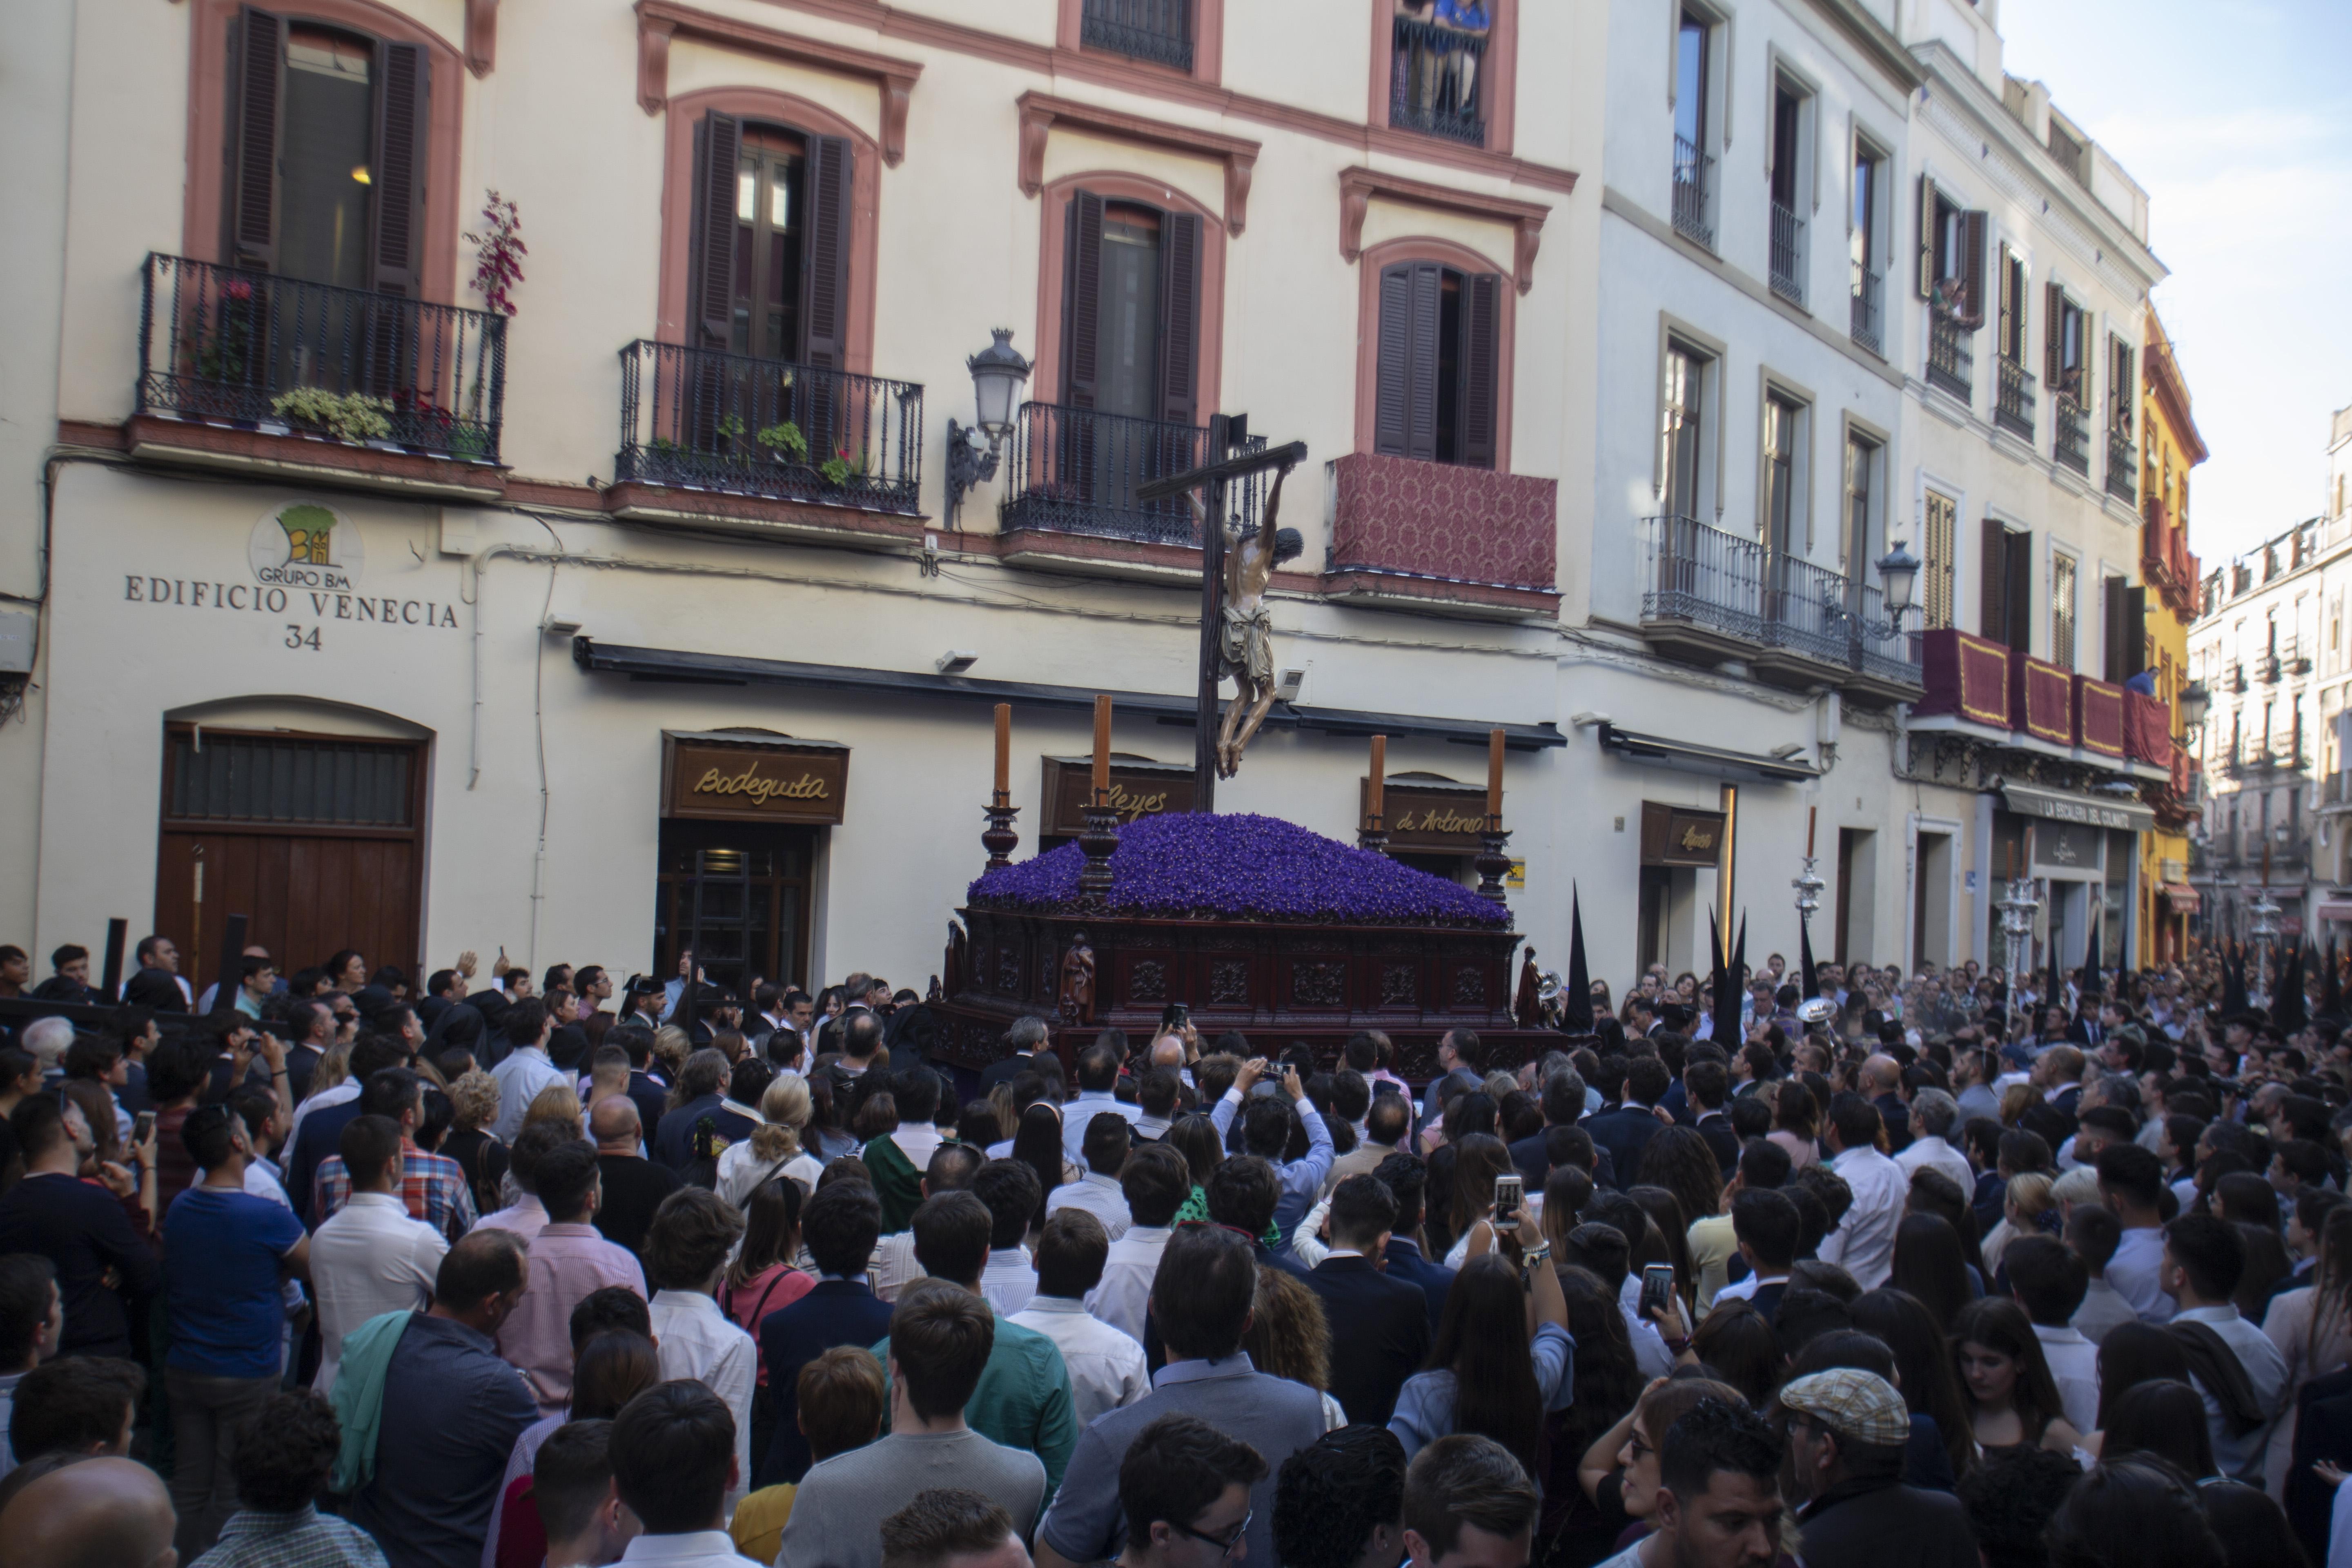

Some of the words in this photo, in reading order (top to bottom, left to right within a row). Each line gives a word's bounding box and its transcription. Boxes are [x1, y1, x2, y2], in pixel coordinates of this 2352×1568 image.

[259, 567, 320, 586] GRUPO
[325, 573, 351, 589] BM
[124, 575, 287, 613] EDIFICIO
[309, 592, 459, 628] VENECIA
[285, 625, 322, 651] 34
[694, 760, 829, 805] Bodeguita
[1396, 811, 1416, 831] de
[1420, 808, 1484, 833] Antonio
[2045, 800, 2054, 817] LA
